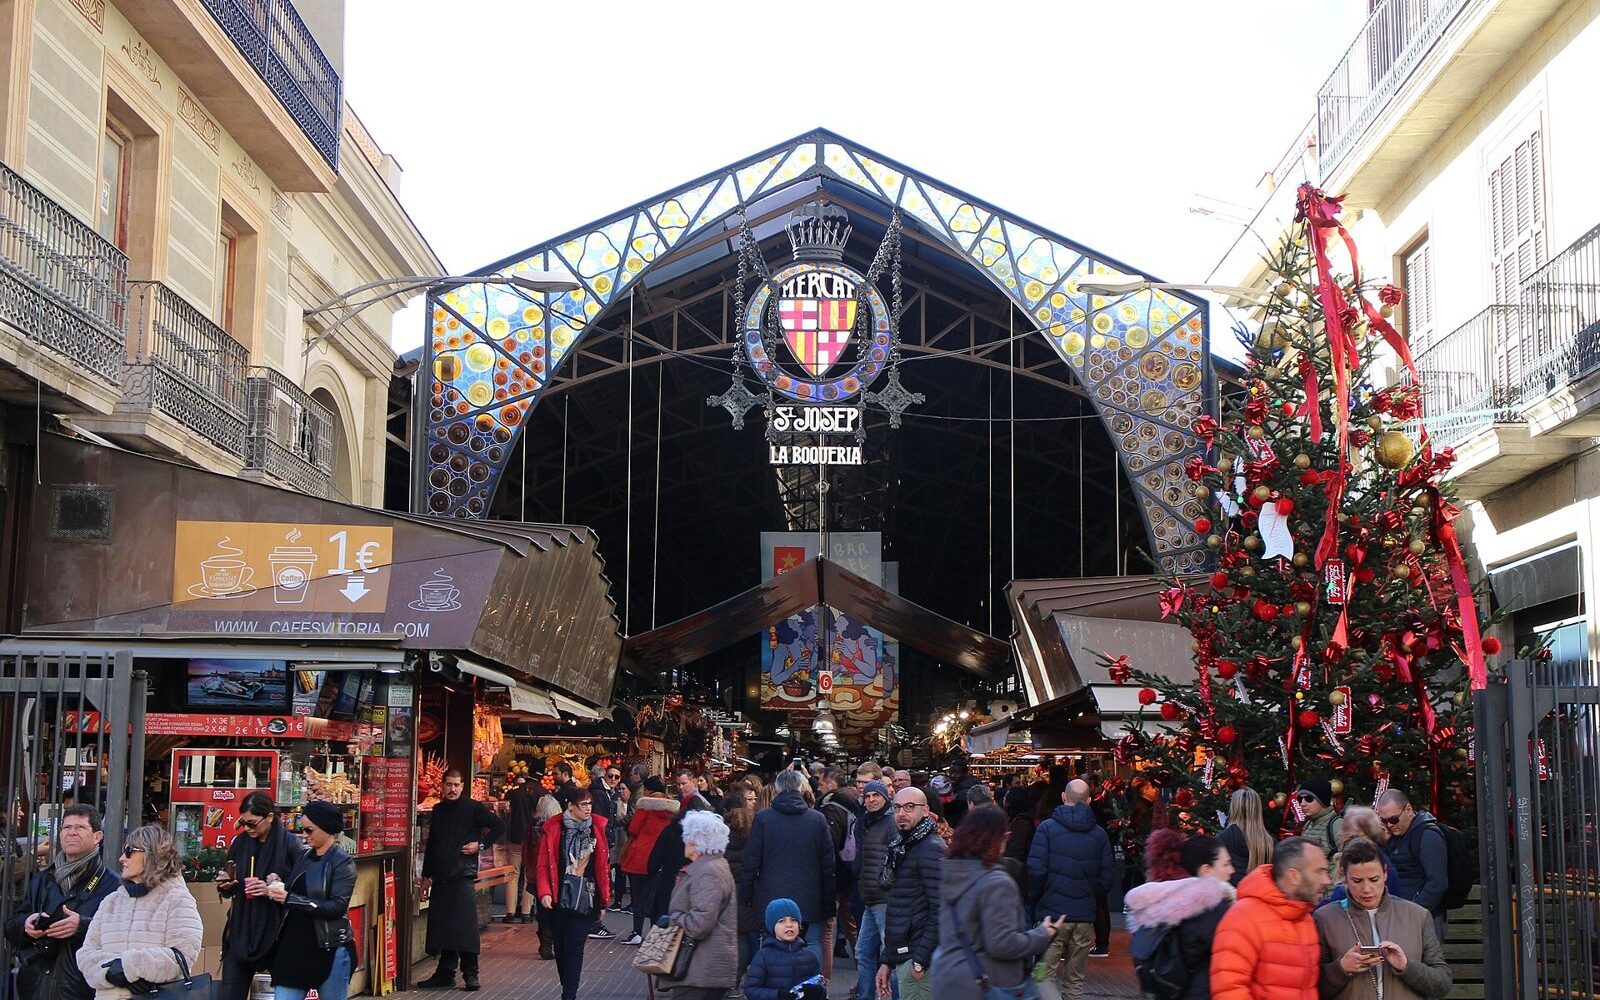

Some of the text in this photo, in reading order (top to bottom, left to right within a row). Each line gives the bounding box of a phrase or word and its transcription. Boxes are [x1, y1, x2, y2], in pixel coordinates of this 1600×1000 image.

[782, 272, 856, 298] MERCAT
[793, 407, 859, 432] JOSEP
[770, 446, 862, 465] LA BOQUERIA
[327, 530, 380, 575] 1€
[833, 542, 869, 557] BAR
[823, 676, 829, 688] 6
